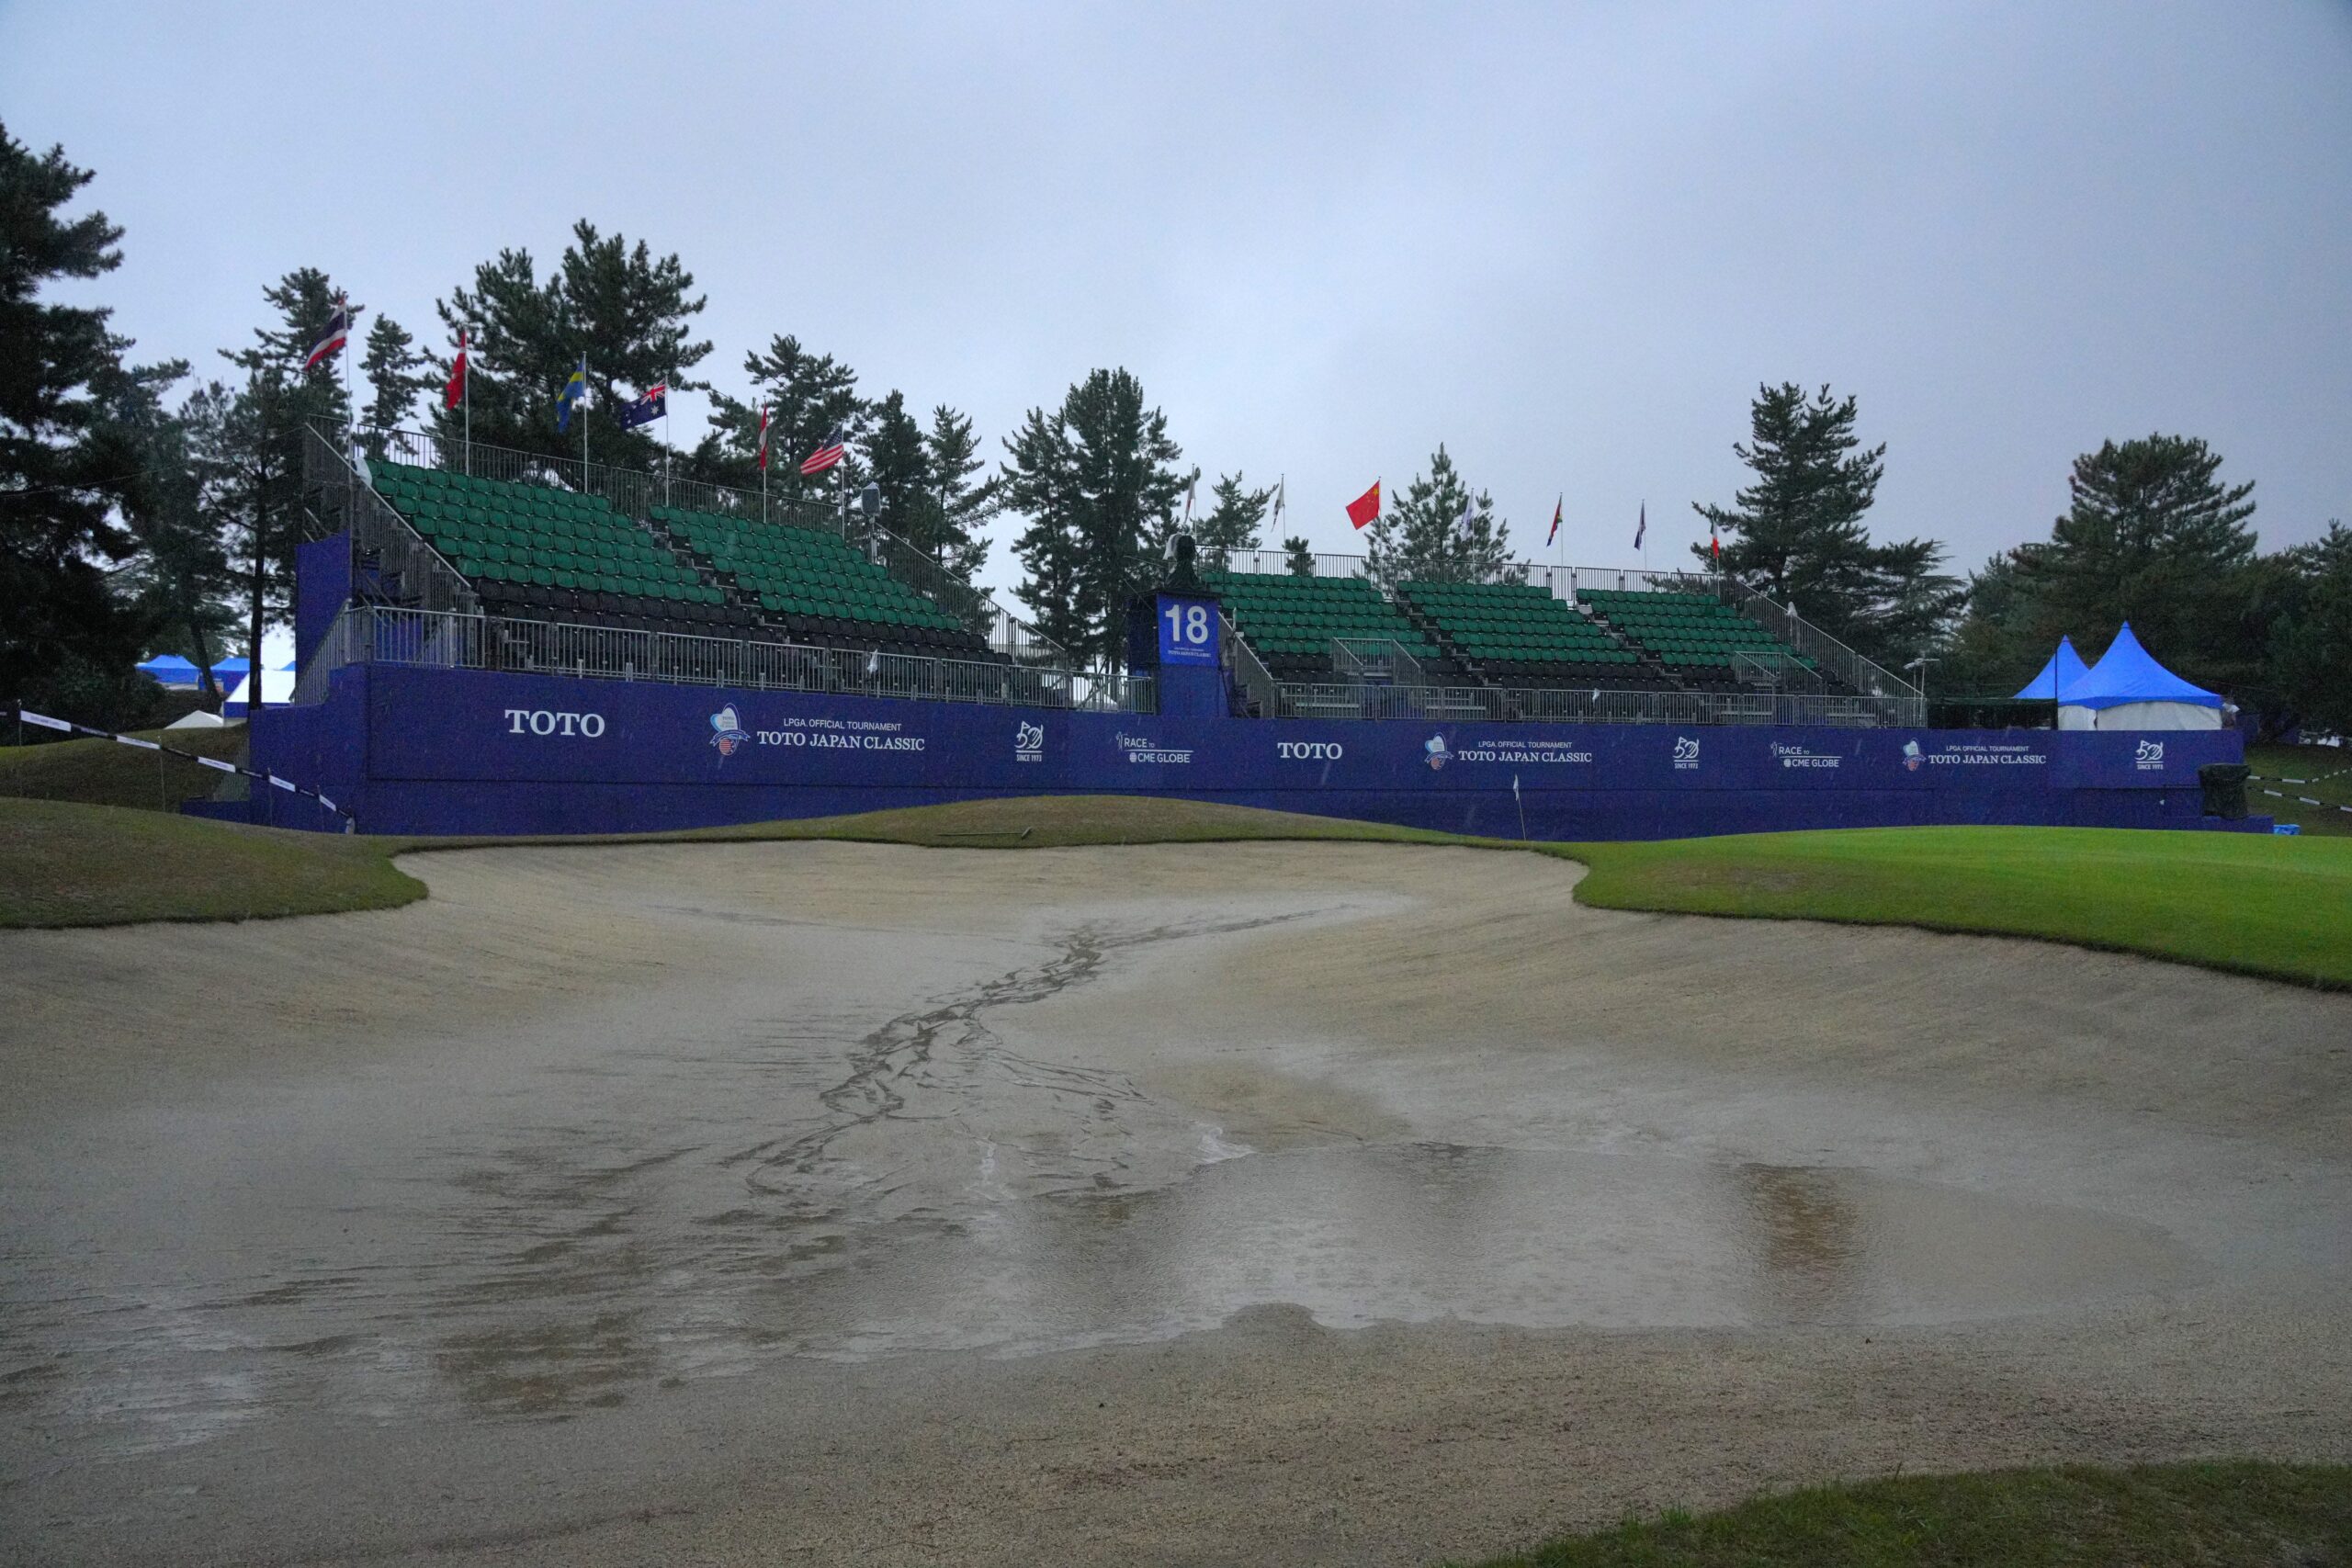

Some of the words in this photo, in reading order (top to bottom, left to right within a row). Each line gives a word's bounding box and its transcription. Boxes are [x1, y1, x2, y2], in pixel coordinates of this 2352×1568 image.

[1165, 604, 1209, 644] 18
[504, 709, 605, 738] TOTO
[808, 719, 845, 729] OFFICIAL
[847, 721, 902, 731] TOURNAMENT
[756, 731, 806, 746] TOTO
[809, 734, 862, 749] JAPAN
[864, 736, 925, 750] CLASSIC
[1124, 738, 1148, 748] RACE
[1277, 742, 1343, 760] TOTO
[1458, 750, 1496, 761] TOTO
[1498, 751, 1540, 762] JAPAN
[1541, 752, 1592, 762] CLASSIC
[1779, 746, 1803, 755] RACE
[1016, 754, 1030, 762] SINCE
[1031, 754, 1043, 762] 1973
[1137, 753, 1156, 762] CME
[1157, 753, 1191, 763] GLOBE
[1792, 759, 1810, 767] CME
[1811, 759, 1839, 768] GLOBE
[1928, 754, 1961, 764] TOTO
[1962, 754, 1999, 764] JAPAN
[2000, 754, 2047, 764] CLASSIC
